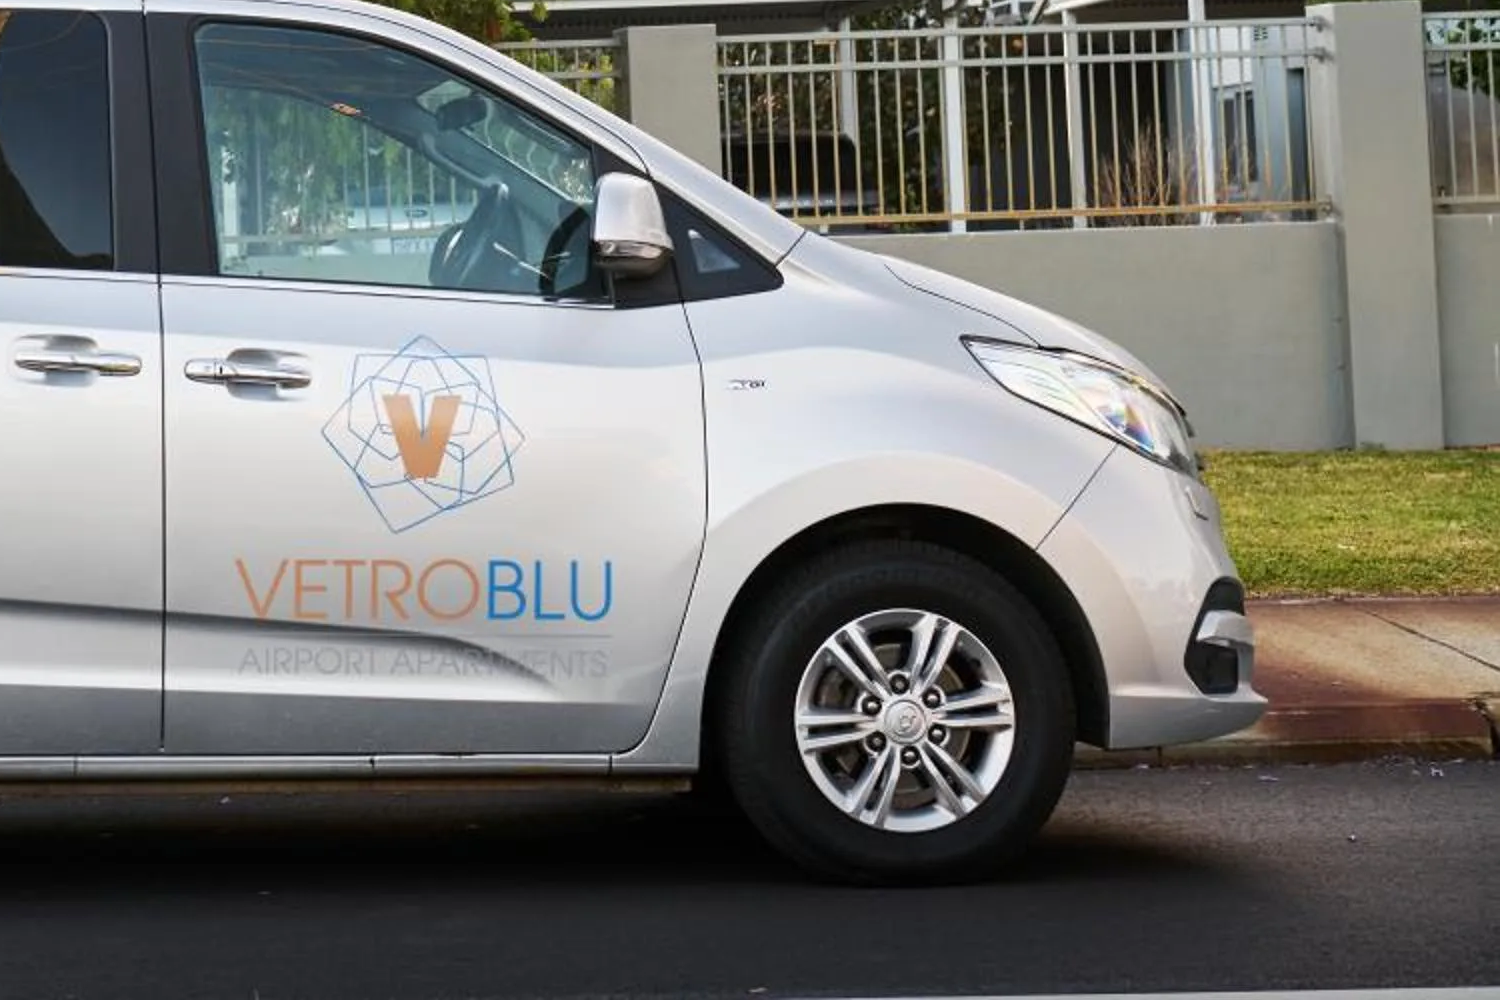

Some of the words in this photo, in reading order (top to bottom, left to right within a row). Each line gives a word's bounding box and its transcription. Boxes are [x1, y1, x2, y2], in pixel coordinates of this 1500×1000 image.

[382, 394, 461, 479] V
[236, 558, 612, 622] VETROBLU
[239, 647, 380, 676] AIRPORT
[390, 647, 607, 678] APARENTS
